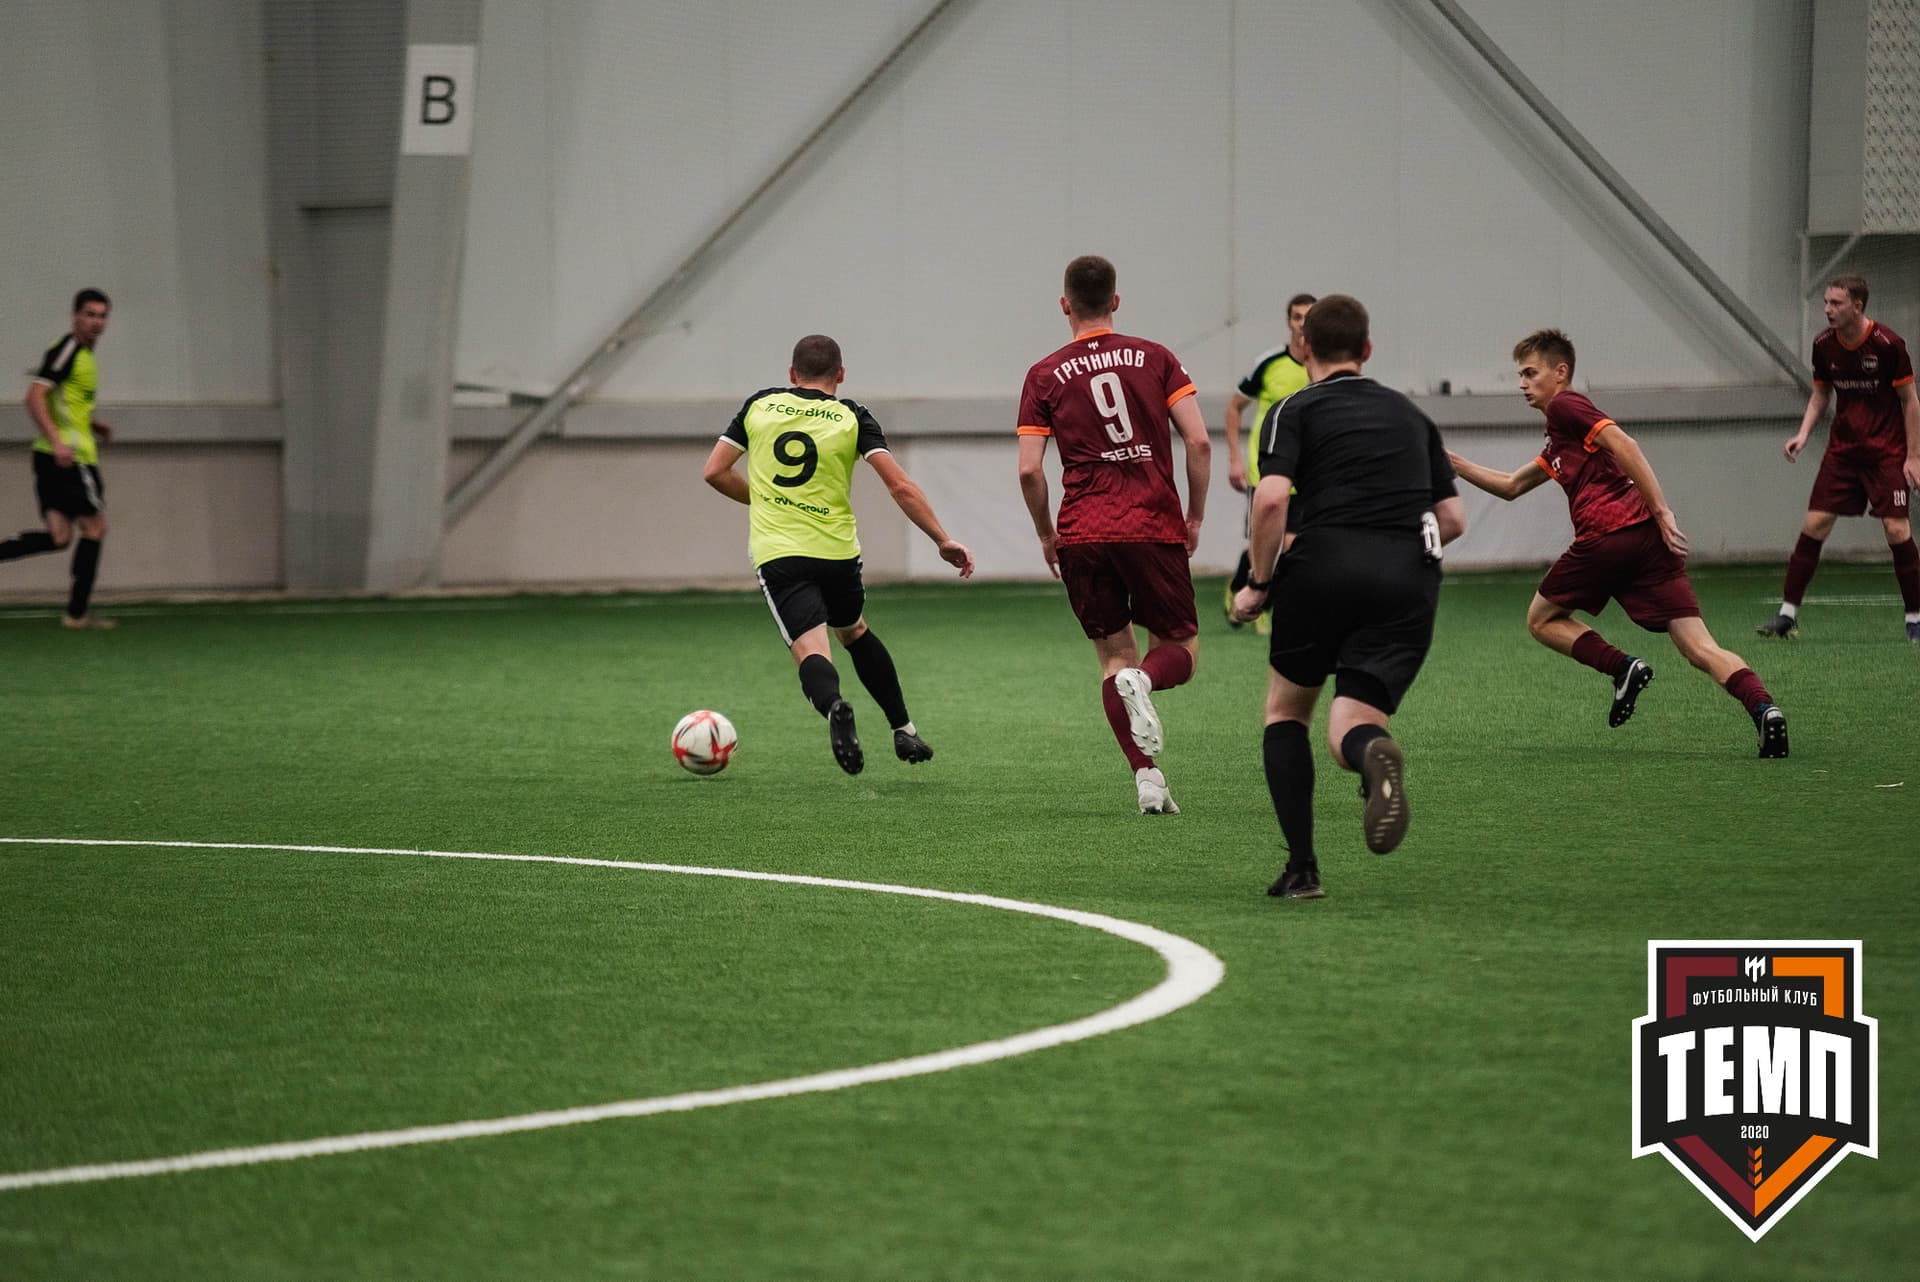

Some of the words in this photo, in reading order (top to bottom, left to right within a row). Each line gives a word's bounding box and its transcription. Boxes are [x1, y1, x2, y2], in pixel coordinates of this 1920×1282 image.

[1053, 348, 1145, 384] ГРЕЧНИКОВ
[1090, 371, 1134, 444] 9
[772, 430, 818, 487] 9
[1100, 444, 1152, 462] SEUS
